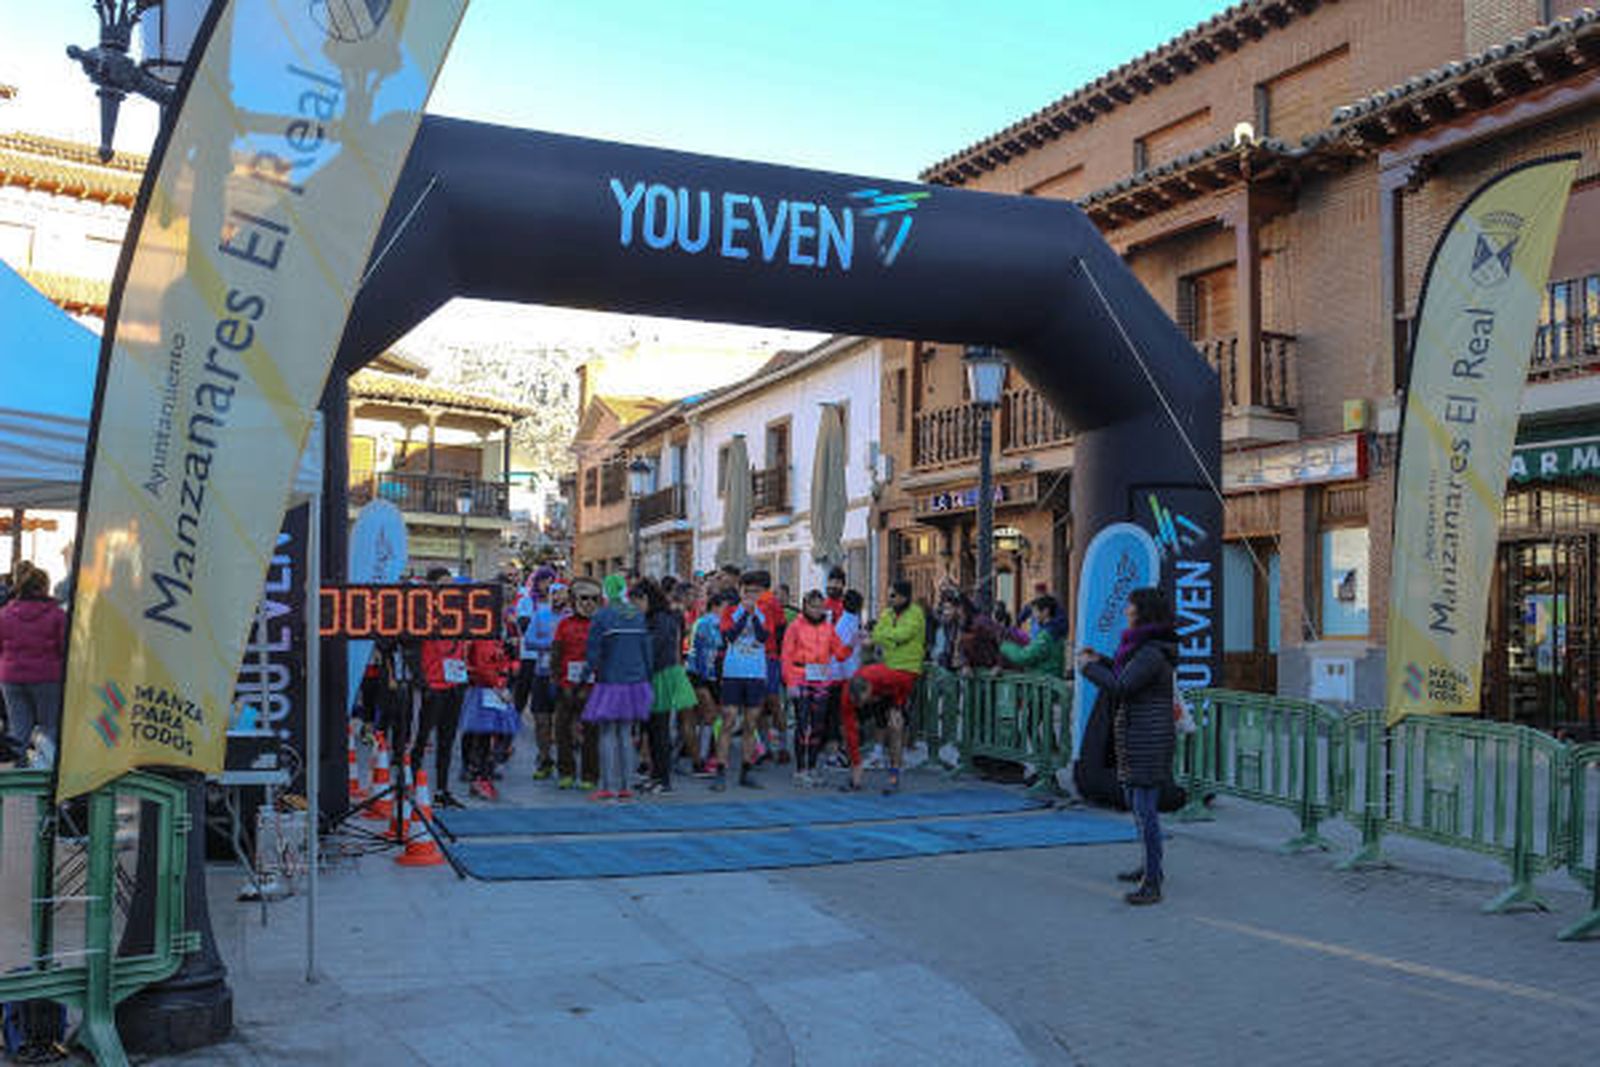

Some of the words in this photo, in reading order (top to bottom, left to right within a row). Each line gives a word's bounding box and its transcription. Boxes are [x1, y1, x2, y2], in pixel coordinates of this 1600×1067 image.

[249, 63, 343, 197] Real
[218, 208, 291, 272] El
[609, 178, 711, 254] YOU
[721, 192, 854, 271] EVEN
[1452, 307, 1496, 380] Real
[143, 331, 188, 498] Ayuntamiento
[1444, 394, 1480, 425] El
[143, 288, 267, 634] Manzanares
[1428, 438, 1472, 636] Manzanares
[1175, 560, 1212, 659] EVEN
[130, 704, 183, 728] PARA
[130, 721, 193, 757] TODOS
[134, 685, 204, 725] MANZA
